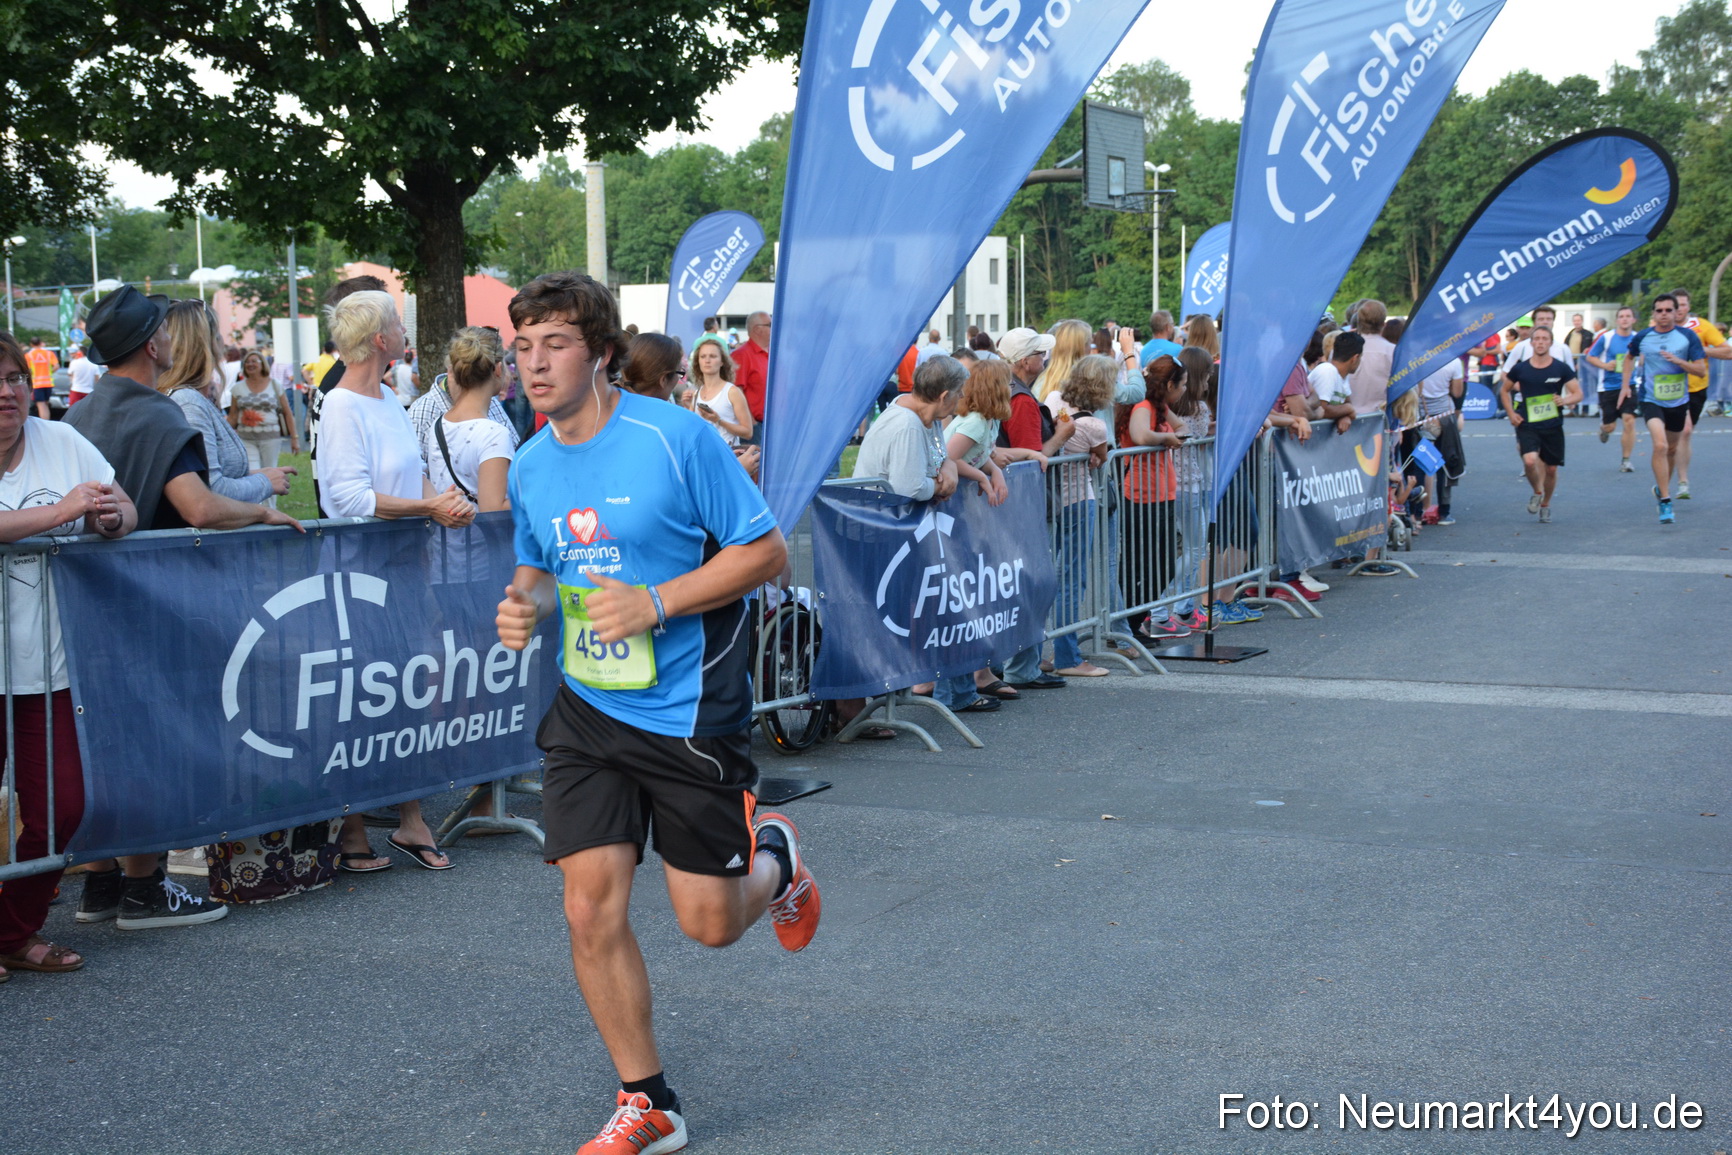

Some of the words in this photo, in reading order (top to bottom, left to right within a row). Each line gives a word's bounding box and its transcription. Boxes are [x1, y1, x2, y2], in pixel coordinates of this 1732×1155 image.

[993, 0, 1080, 114] AUTO
[1351, 0, 1465, 181] AUTOMOBILE
[690, 226, 743, 298] Fischer
[1438, 209, 1604, 313] Frischmann
[1545, 241, 1586, 269] Druck
[1587, 226, 1613, 246] und
[1612, 197, 1660, 232] Medien
[709, 240, 750, 297] AUTOMOBILE
[1534, 404, 1551, 415] 674
[1658, 383, 1682, 394] 1332
[1282, 466, 1363, 509] Frischmann
[551, 517, 568, 547] I
[559, 544, 621, 564] camping
[913, 553, 1024, 619] Fischer
[923, 606, 1020, 649] AUTOMOBILE
[295, 629, 542, 731] Fischer
[323, 703, 525, 775] AUTOMOBILE
